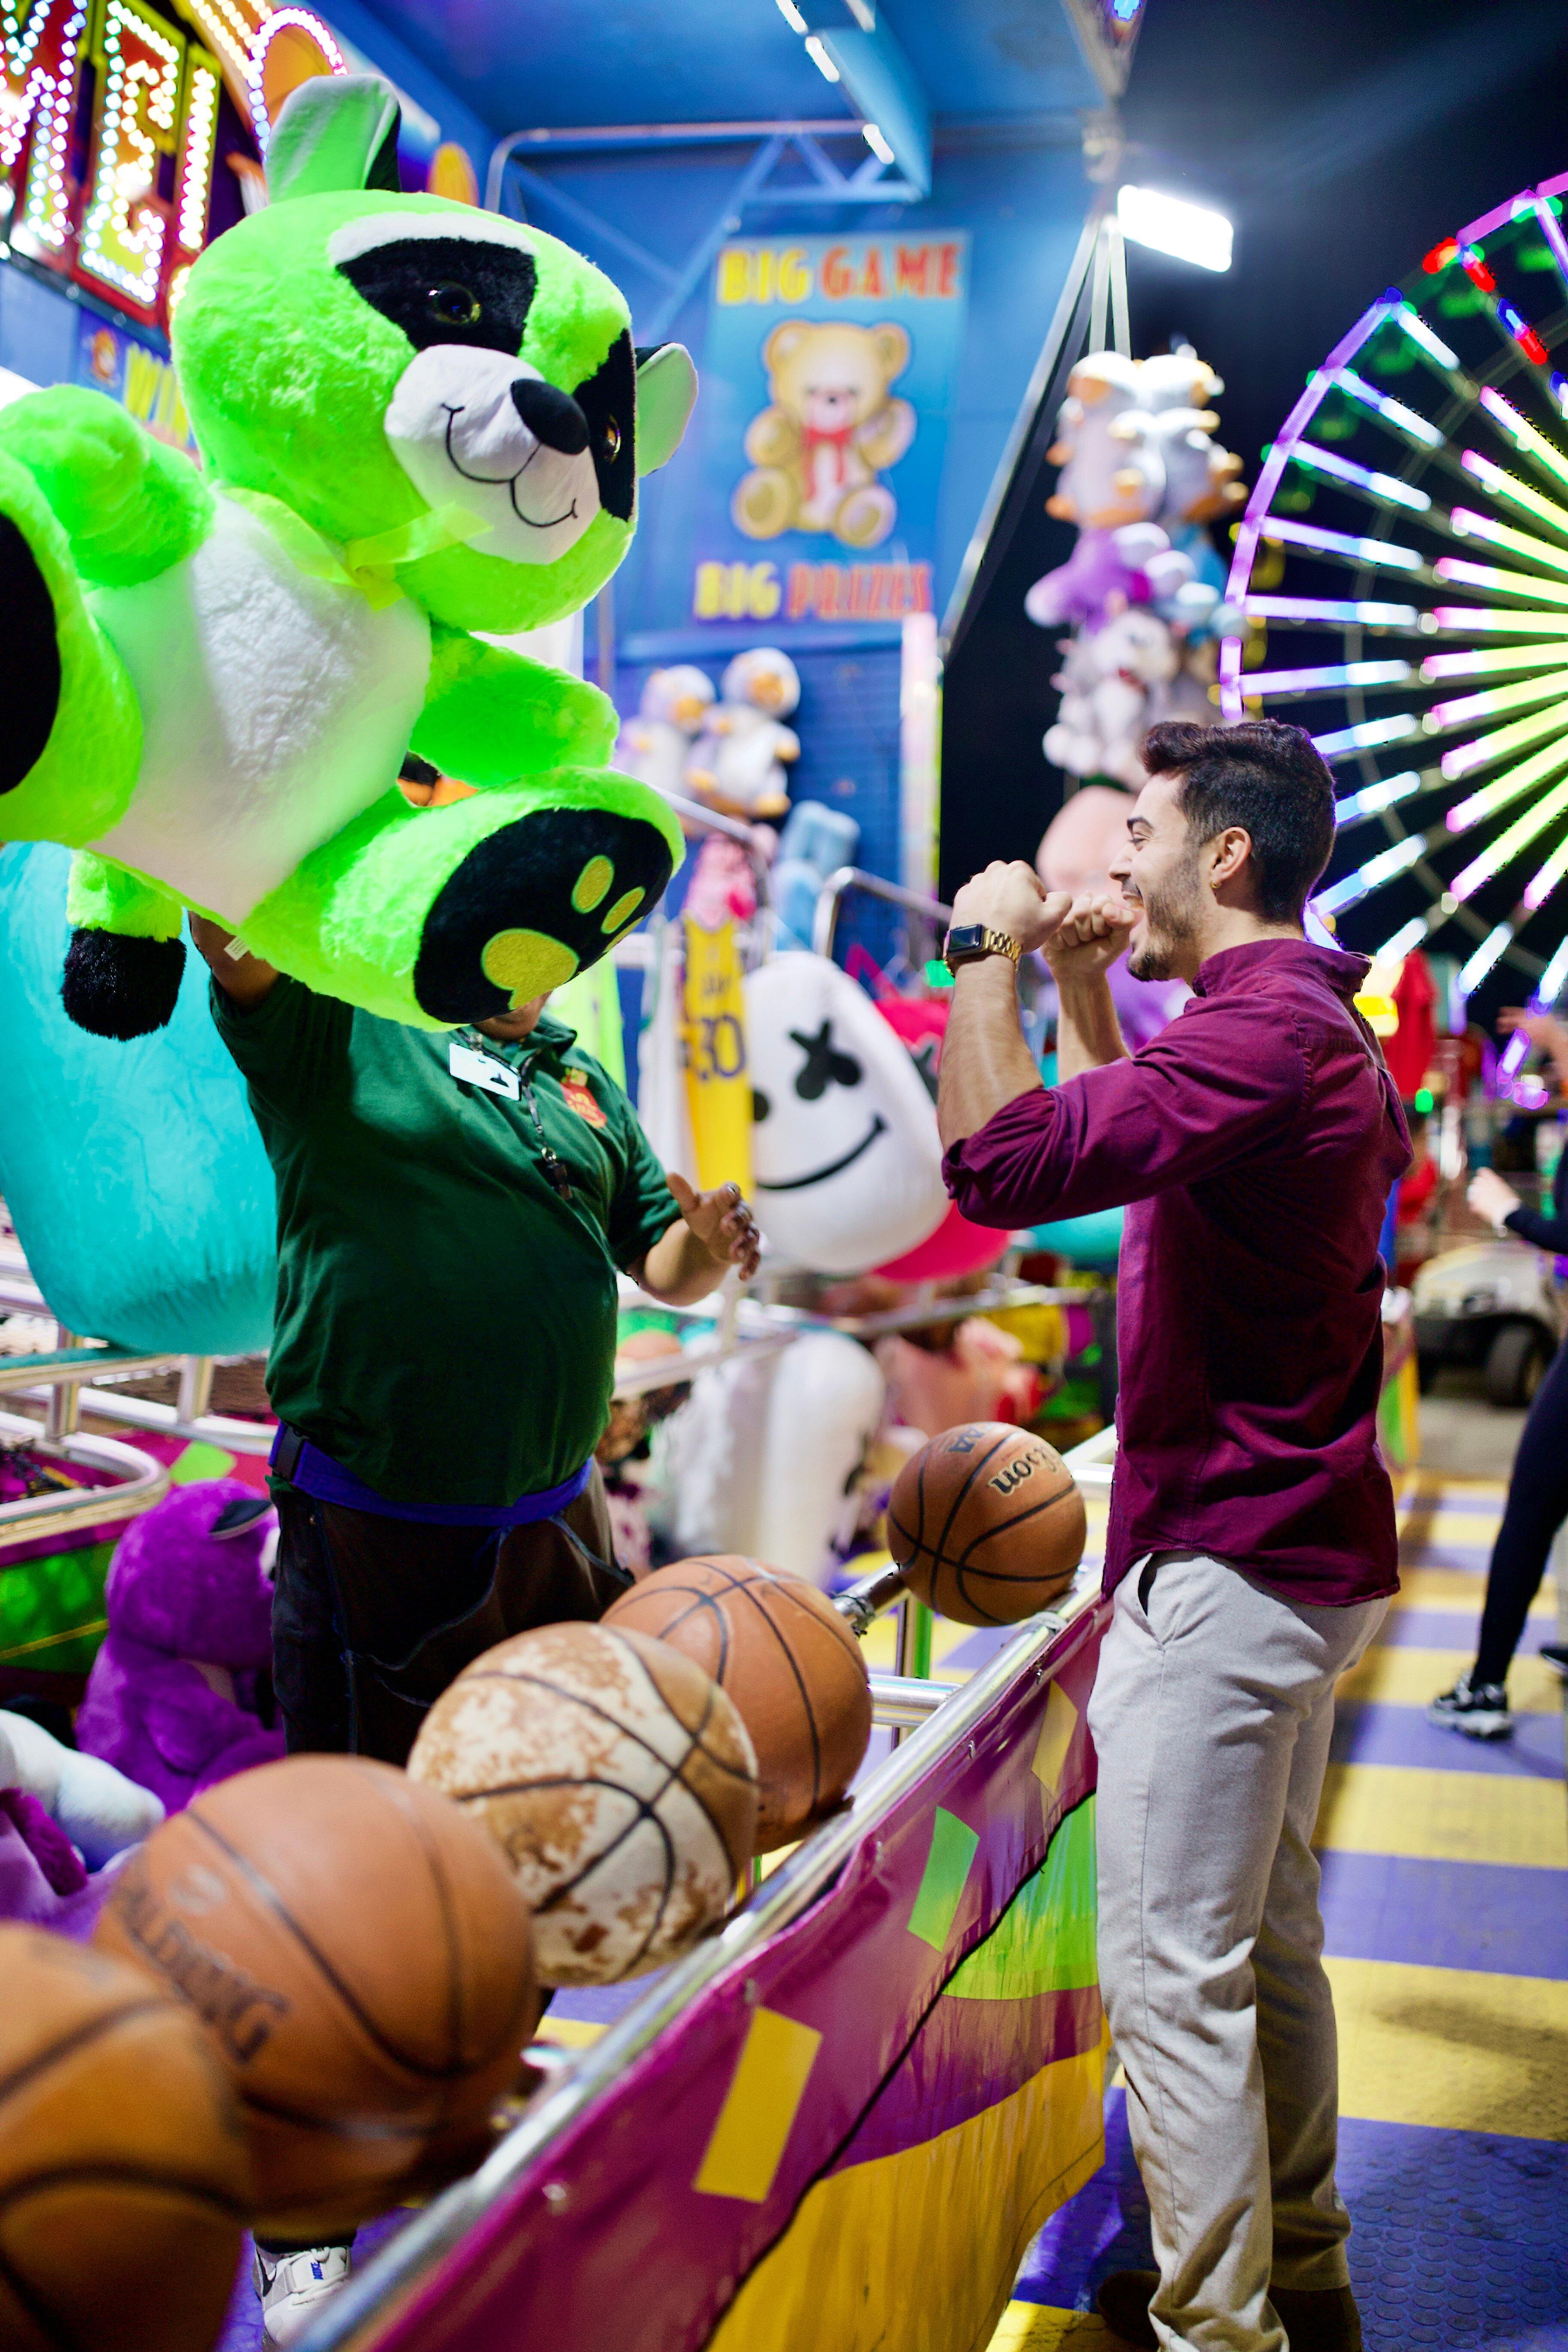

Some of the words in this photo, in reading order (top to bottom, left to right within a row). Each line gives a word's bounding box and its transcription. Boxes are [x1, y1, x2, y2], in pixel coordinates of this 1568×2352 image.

[721, 248, 810, 303] BIG
[821, 243, 959, 300] GAME
[696, 562, 780, 619] BIG
